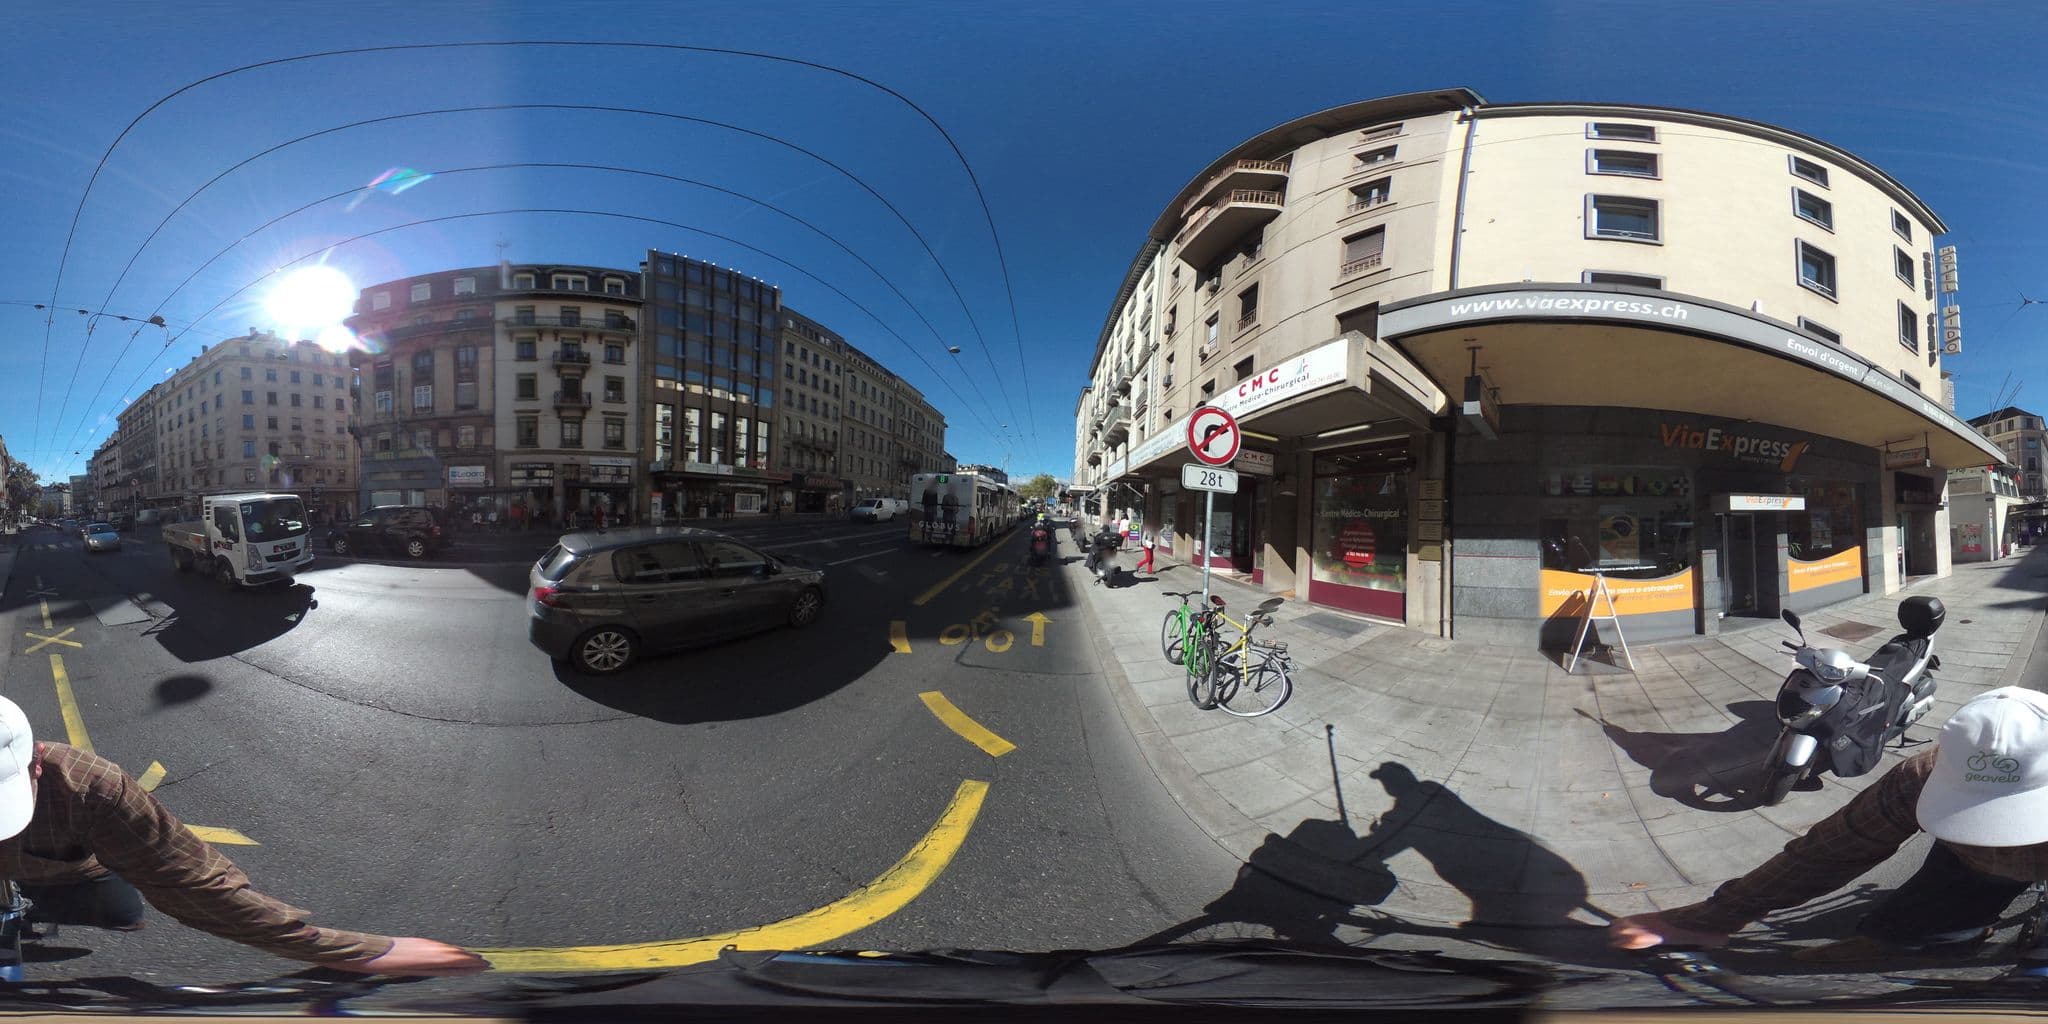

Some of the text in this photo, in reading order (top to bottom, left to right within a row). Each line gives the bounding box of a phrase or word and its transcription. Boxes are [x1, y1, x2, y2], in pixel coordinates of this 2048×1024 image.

[1450, 295, 1689, 320] www.vaexpress.ch
[1942, 247, 1957, 351] HOTEL LIDO
[1787, 339, 1859, 376] Envoi d'argent
[1659, 422, 1791, 459] ViaExpress
[918, 520, 961, 531] GLOBUS
[1965, 771, 2021, 783] geovelo
